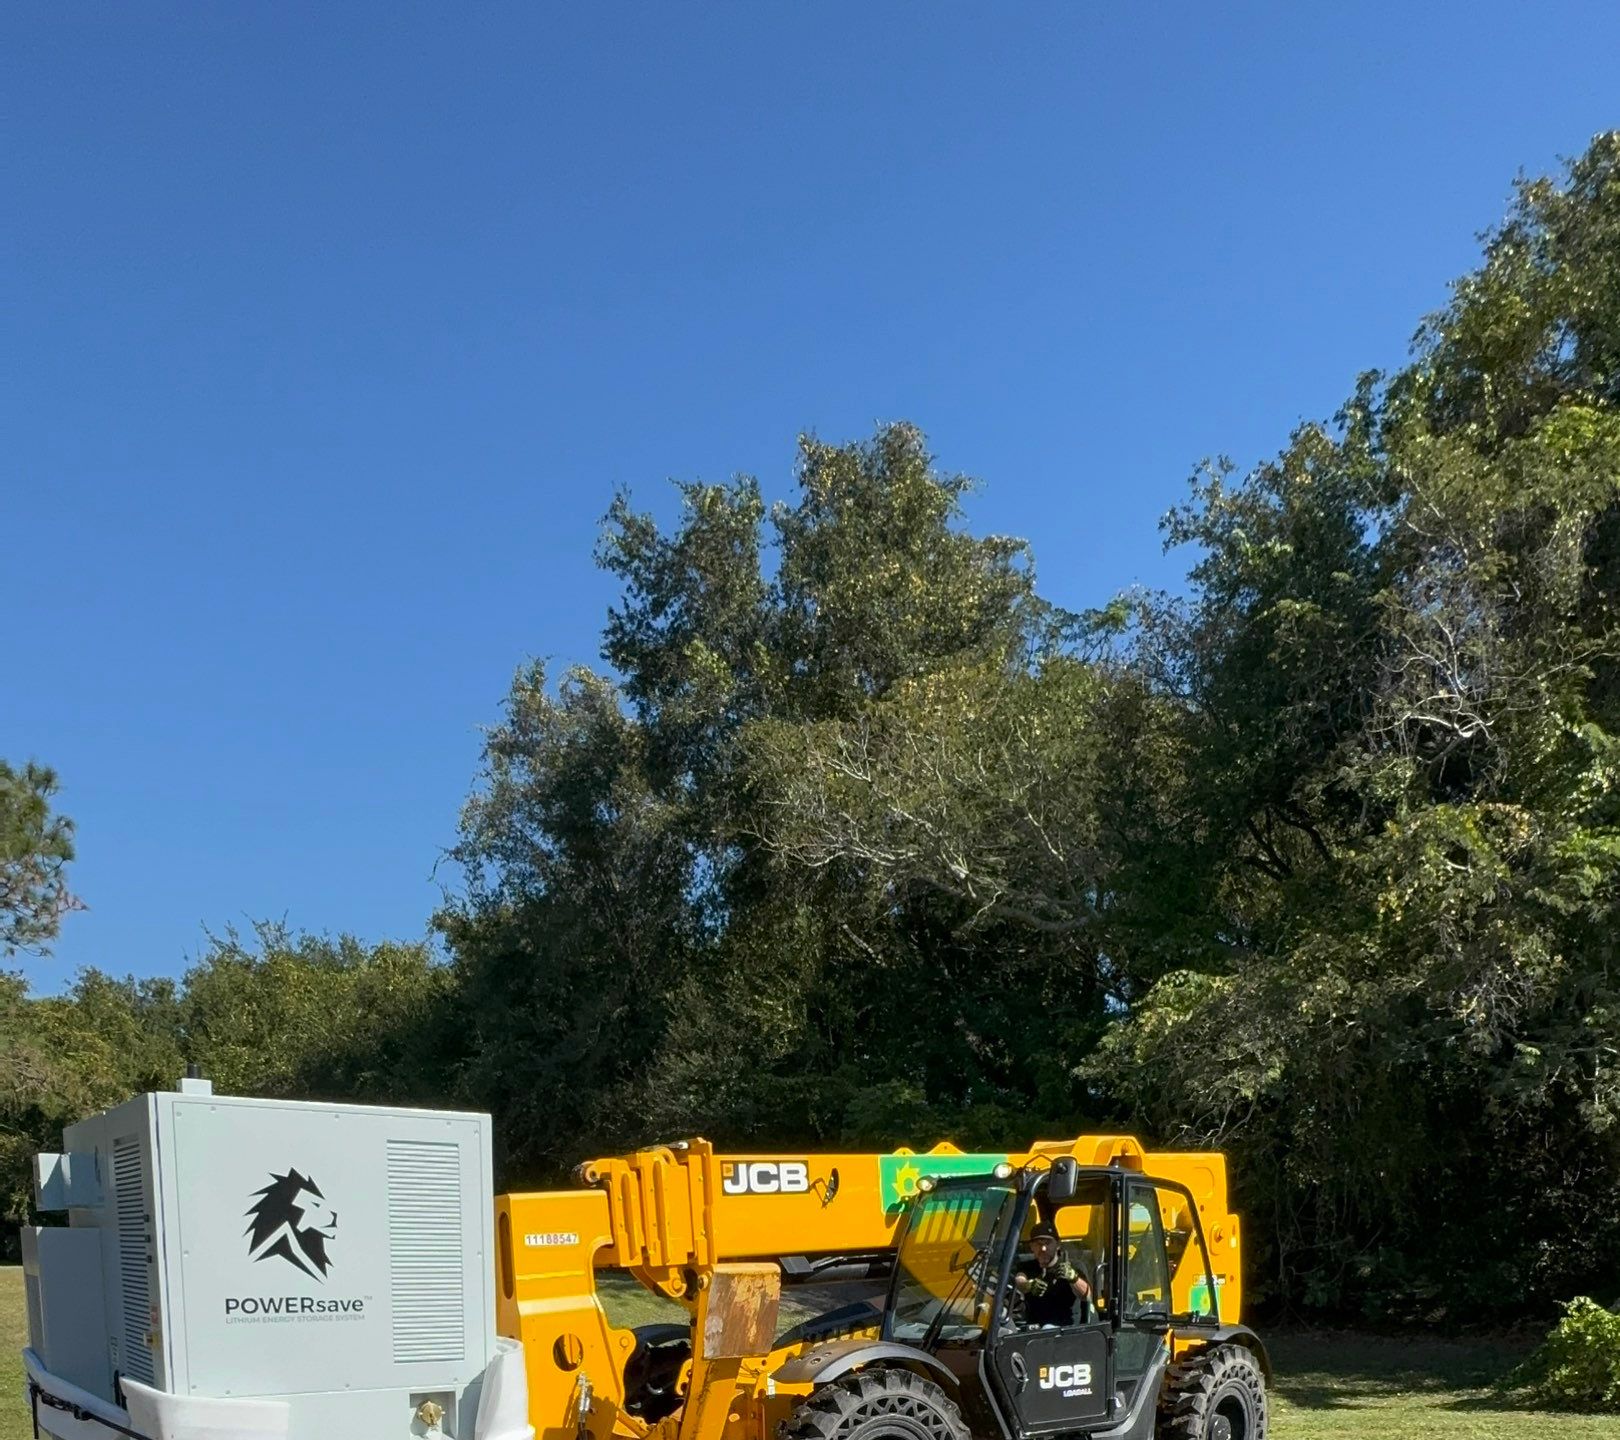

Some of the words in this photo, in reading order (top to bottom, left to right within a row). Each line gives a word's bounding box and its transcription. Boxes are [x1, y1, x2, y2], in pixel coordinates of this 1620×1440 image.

[723, 1163, 809, 1194] JCB
[225, 1296, 363, 1315] POWERsave
[225, 1316, 260, 1325] LITHIUM
[262, 1315, 295, 1324] ENERGY
[296, 1314, 333, 1323] STORAGE
[335, 1313, 365, 1321] SYSTEM
[1039, 1363, 1092, 1389] JCB
